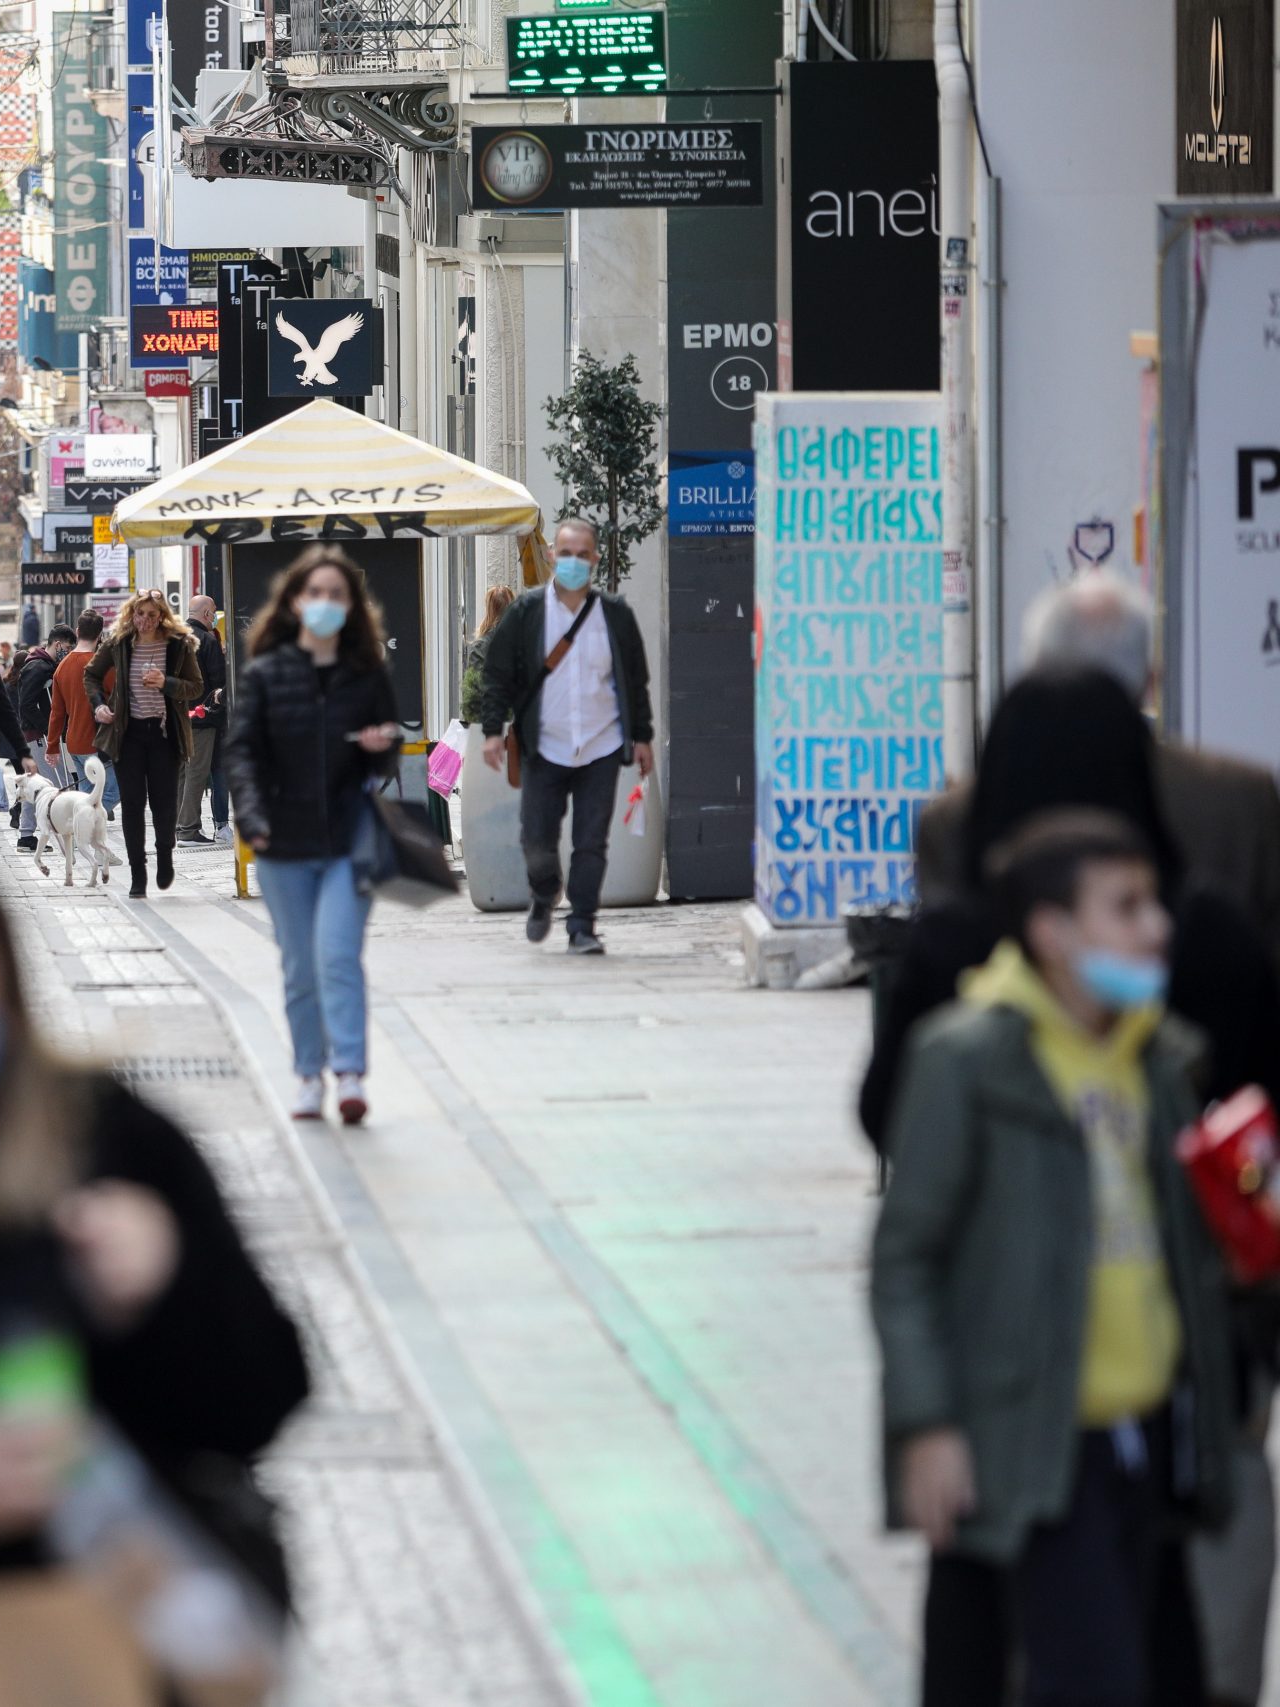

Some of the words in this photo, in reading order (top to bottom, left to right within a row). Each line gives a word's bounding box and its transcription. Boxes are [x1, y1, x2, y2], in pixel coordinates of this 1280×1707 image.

[205, 4, 222, 43] too
[585, 130, 733, 151] ΓΝΩΡΙΜΙΕΣ
[497, 142, 537, 161] VIP
[670, 150, 746, 161] ΣΥΝΟΙΚΕΣΙΑ
[1185, 133, 1252, 168] MOURTZI
[192, 252, 257, 263] ΗΜΙΟΡΟΦΟΣ
[683, 322, 777, 348] ΕΡΜΟ
[148, 373, 187, 387] CAMPER
[727, 375, 752, 392] 18
[92, 458, 146, 468] avvento
[681, 524, 712, 533] ΕΡΜΟΥ
[714, 524, 728, 534] 18,
[24, 572, 86, 585] ROMANO
